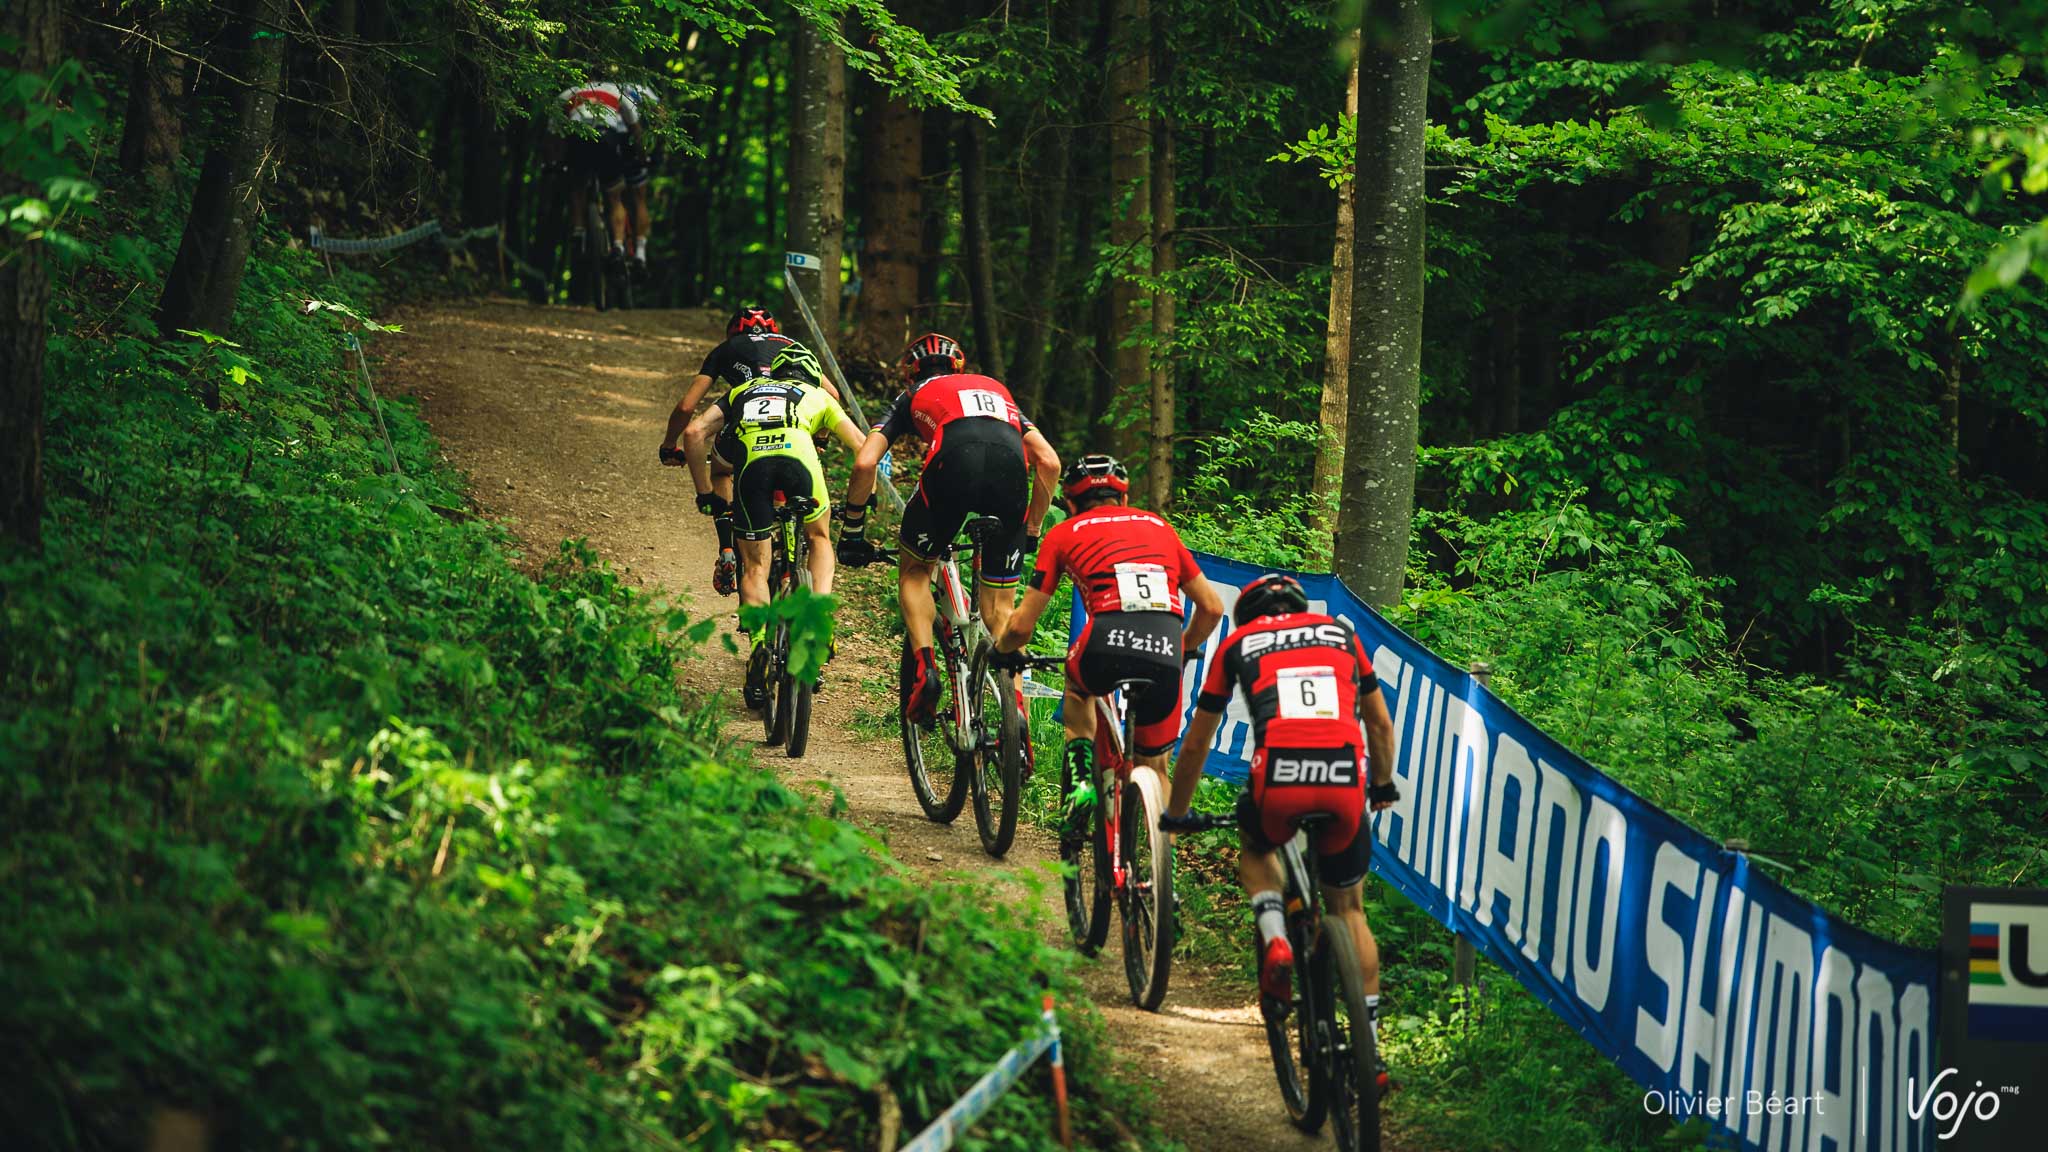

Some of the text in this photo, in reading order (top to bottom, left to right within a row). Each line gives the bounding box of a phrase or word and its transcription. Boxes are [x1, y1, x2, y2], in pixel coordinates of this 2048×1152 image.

[758, 399, 771, 415] 2
[972, 393, 995, 413] 18
[755, 433, 786, 445] BH
[1073, 514, 1165, 532] FOCUS
[1135, 573, 1151, 599] 5
[1106, 629, 1174, 656] fi'zi:k
[1241, 624, 1347, 657] BMC
[1300, 679, 1316, 706] 6
[1273, 757, 1353, 783] BMC
[1635, 840, 1931, 1152] SHIMANO
